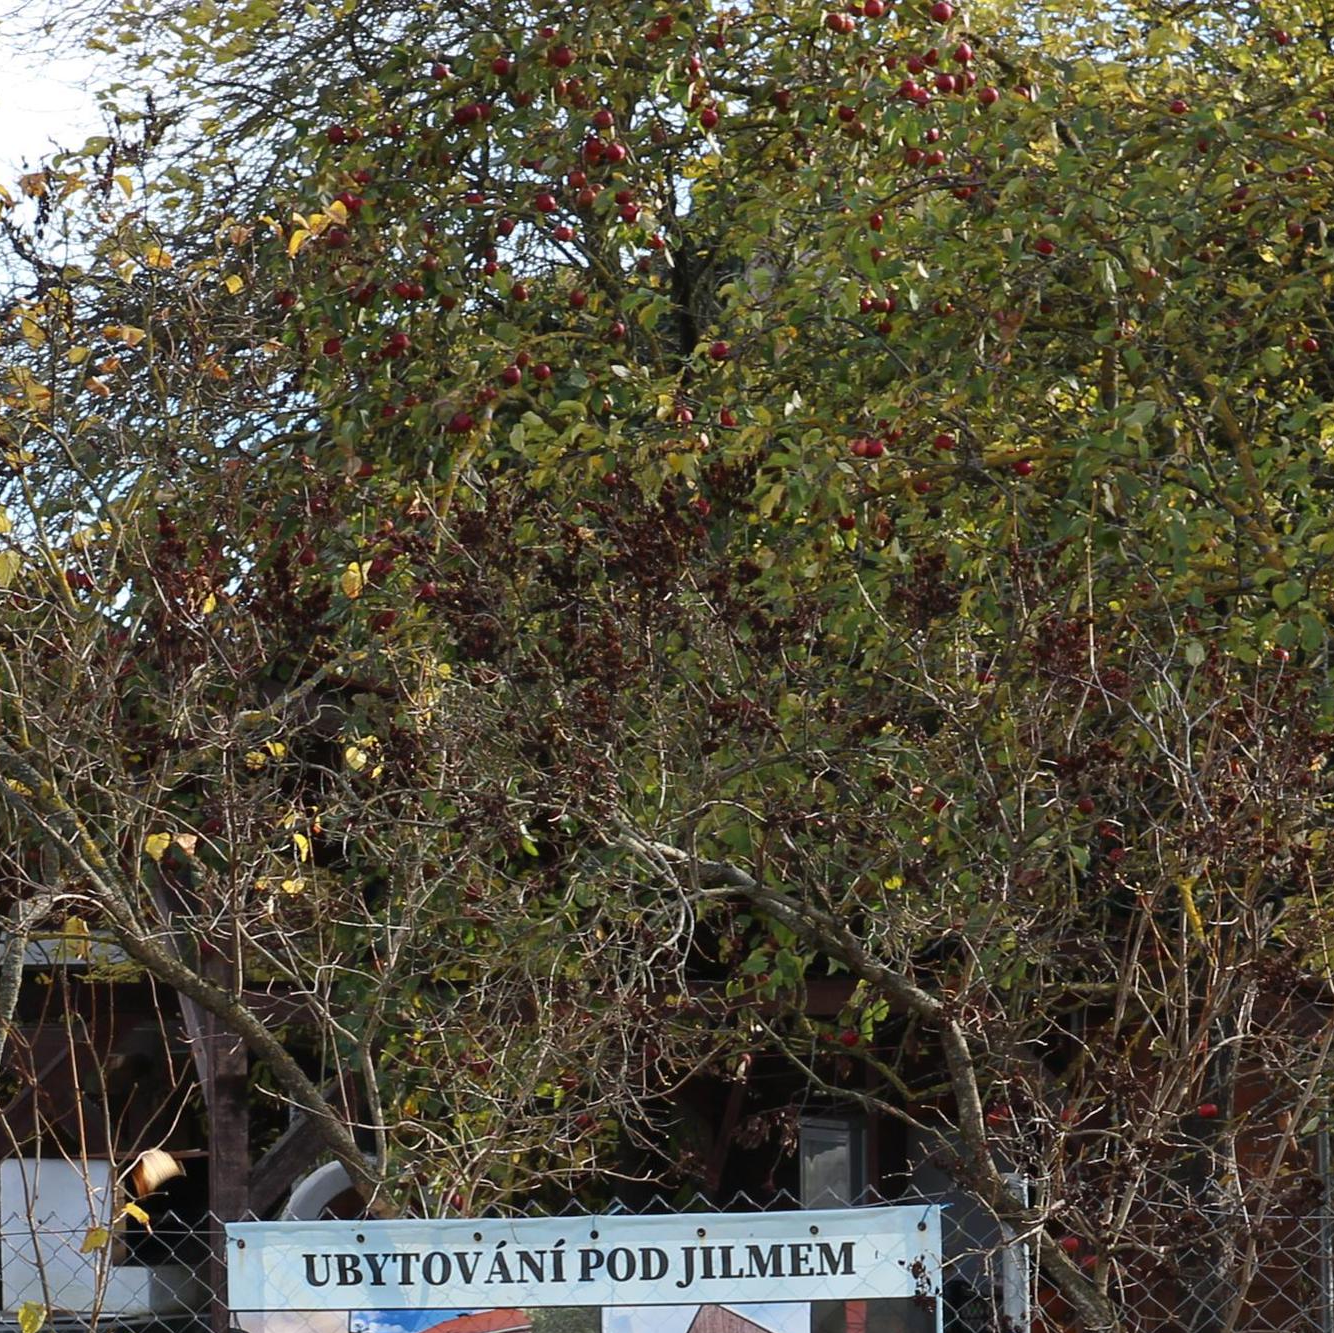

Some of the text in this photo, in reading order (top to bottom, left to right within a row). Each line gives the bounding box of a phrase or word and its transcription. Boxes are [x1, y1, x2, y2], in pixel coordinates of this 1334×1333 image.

[302, 1239, 856, 1288] UBYTOVÁNÍ POD JILMEM
